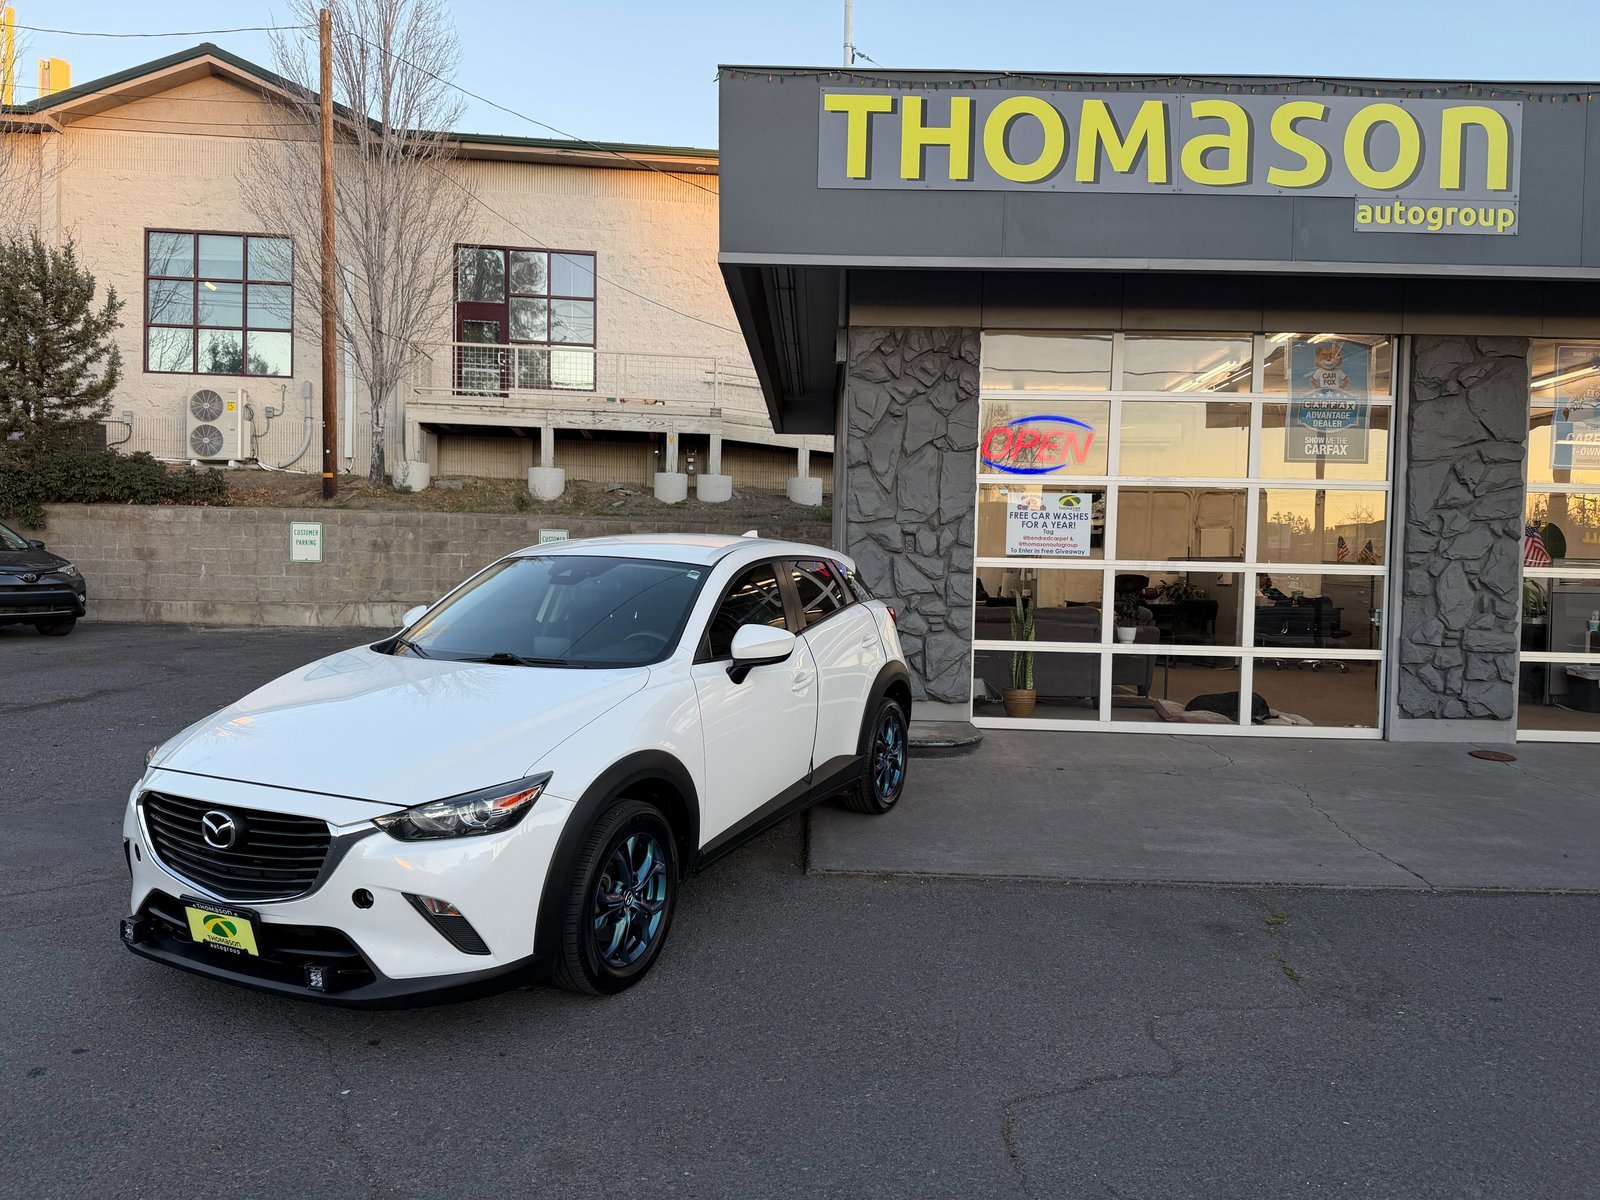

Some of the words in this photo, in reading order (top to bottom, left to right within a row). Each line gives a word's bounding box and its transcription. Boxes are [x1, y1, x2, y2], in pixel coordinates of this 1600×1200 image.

[1356, 201, 1514, 232] autogroup
[1303, 401, 1355, 410] CARFAX
[1305, 411, 1351, 419] ADVANTAGE
[1313, 420, 1343, 428] DEALER
[981, 426, 1095, 464] OPEN
[1304, 436, 1325, 444] SHOW
[1336, 437, 1348, 445] THE
[1304, 444, 1348, 456] CARFAX
[1009, 511, 1029, 520] FREE
[1031, 511, 1051, 520] CAR
[1053, 512, 1089, 521] WASHES
[1021, 520, 1039, 529] FOR
[1041, 521, 1048, 529] A
[1051, 521, 1076, 530] YEAR!
[1043, 528, 1055, 536] Tag
[1054, 548, 1086, 556] Giveaway
[209, 943, 241, 955] autogroup
